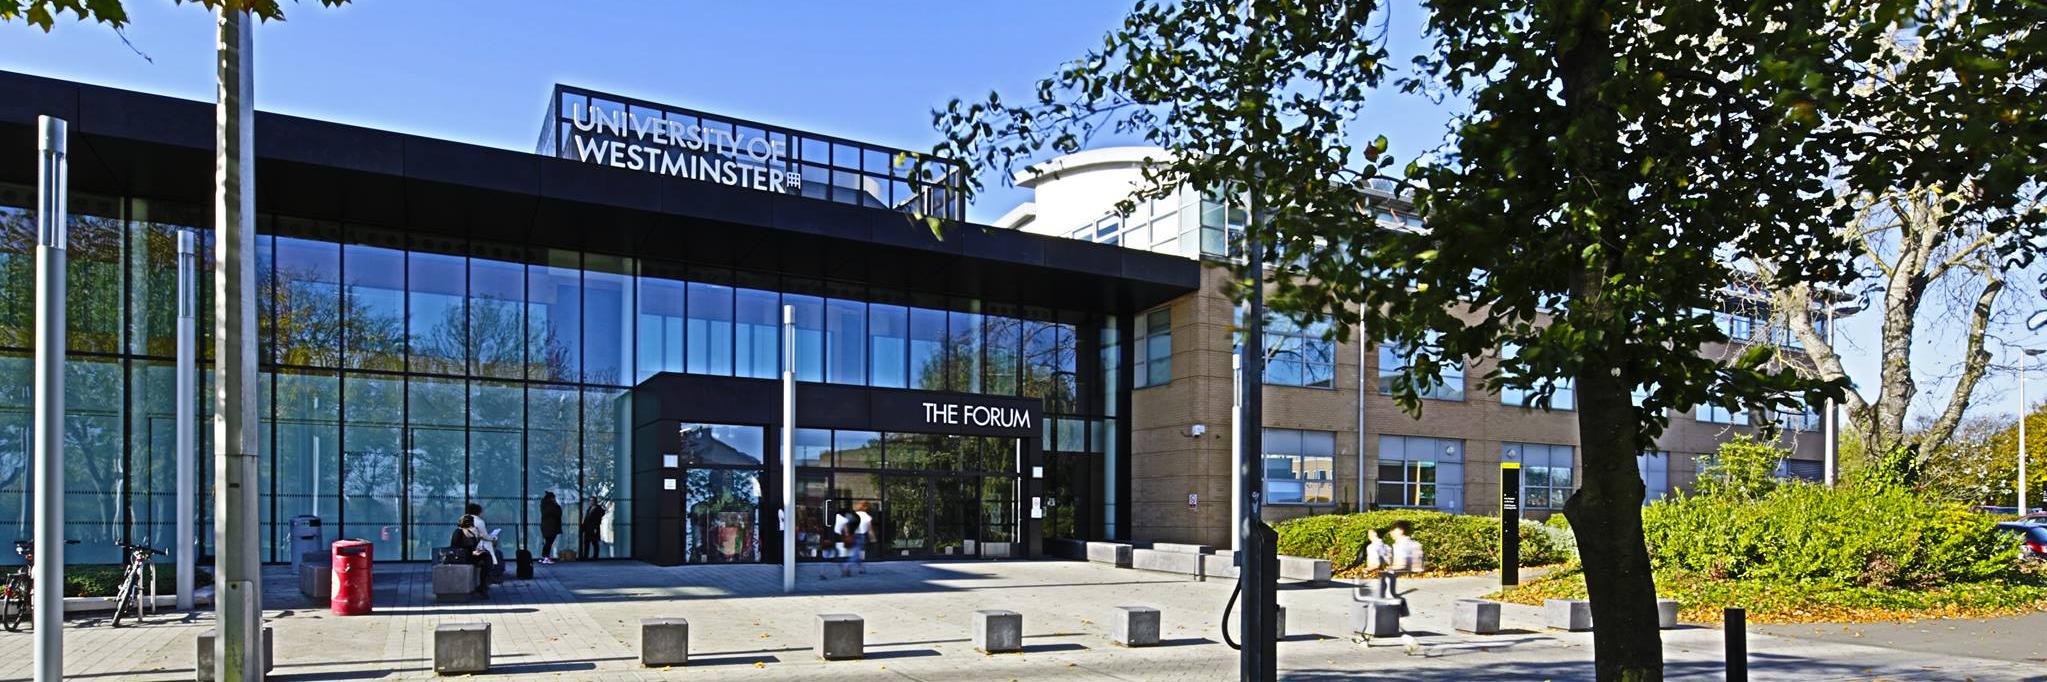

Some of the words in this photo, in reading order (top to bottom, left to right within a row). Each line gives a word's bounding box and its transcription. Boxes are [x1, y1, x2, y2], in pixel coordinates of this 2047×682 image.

[574, 103, 744, 157] UNIVERSITY
[747, 137, 786, 163] OF
[575, 135, 785, 193] WESTMINSTER
[922, 402, 959, 424] THE
[964, 405, 1031, 428] FORUM
